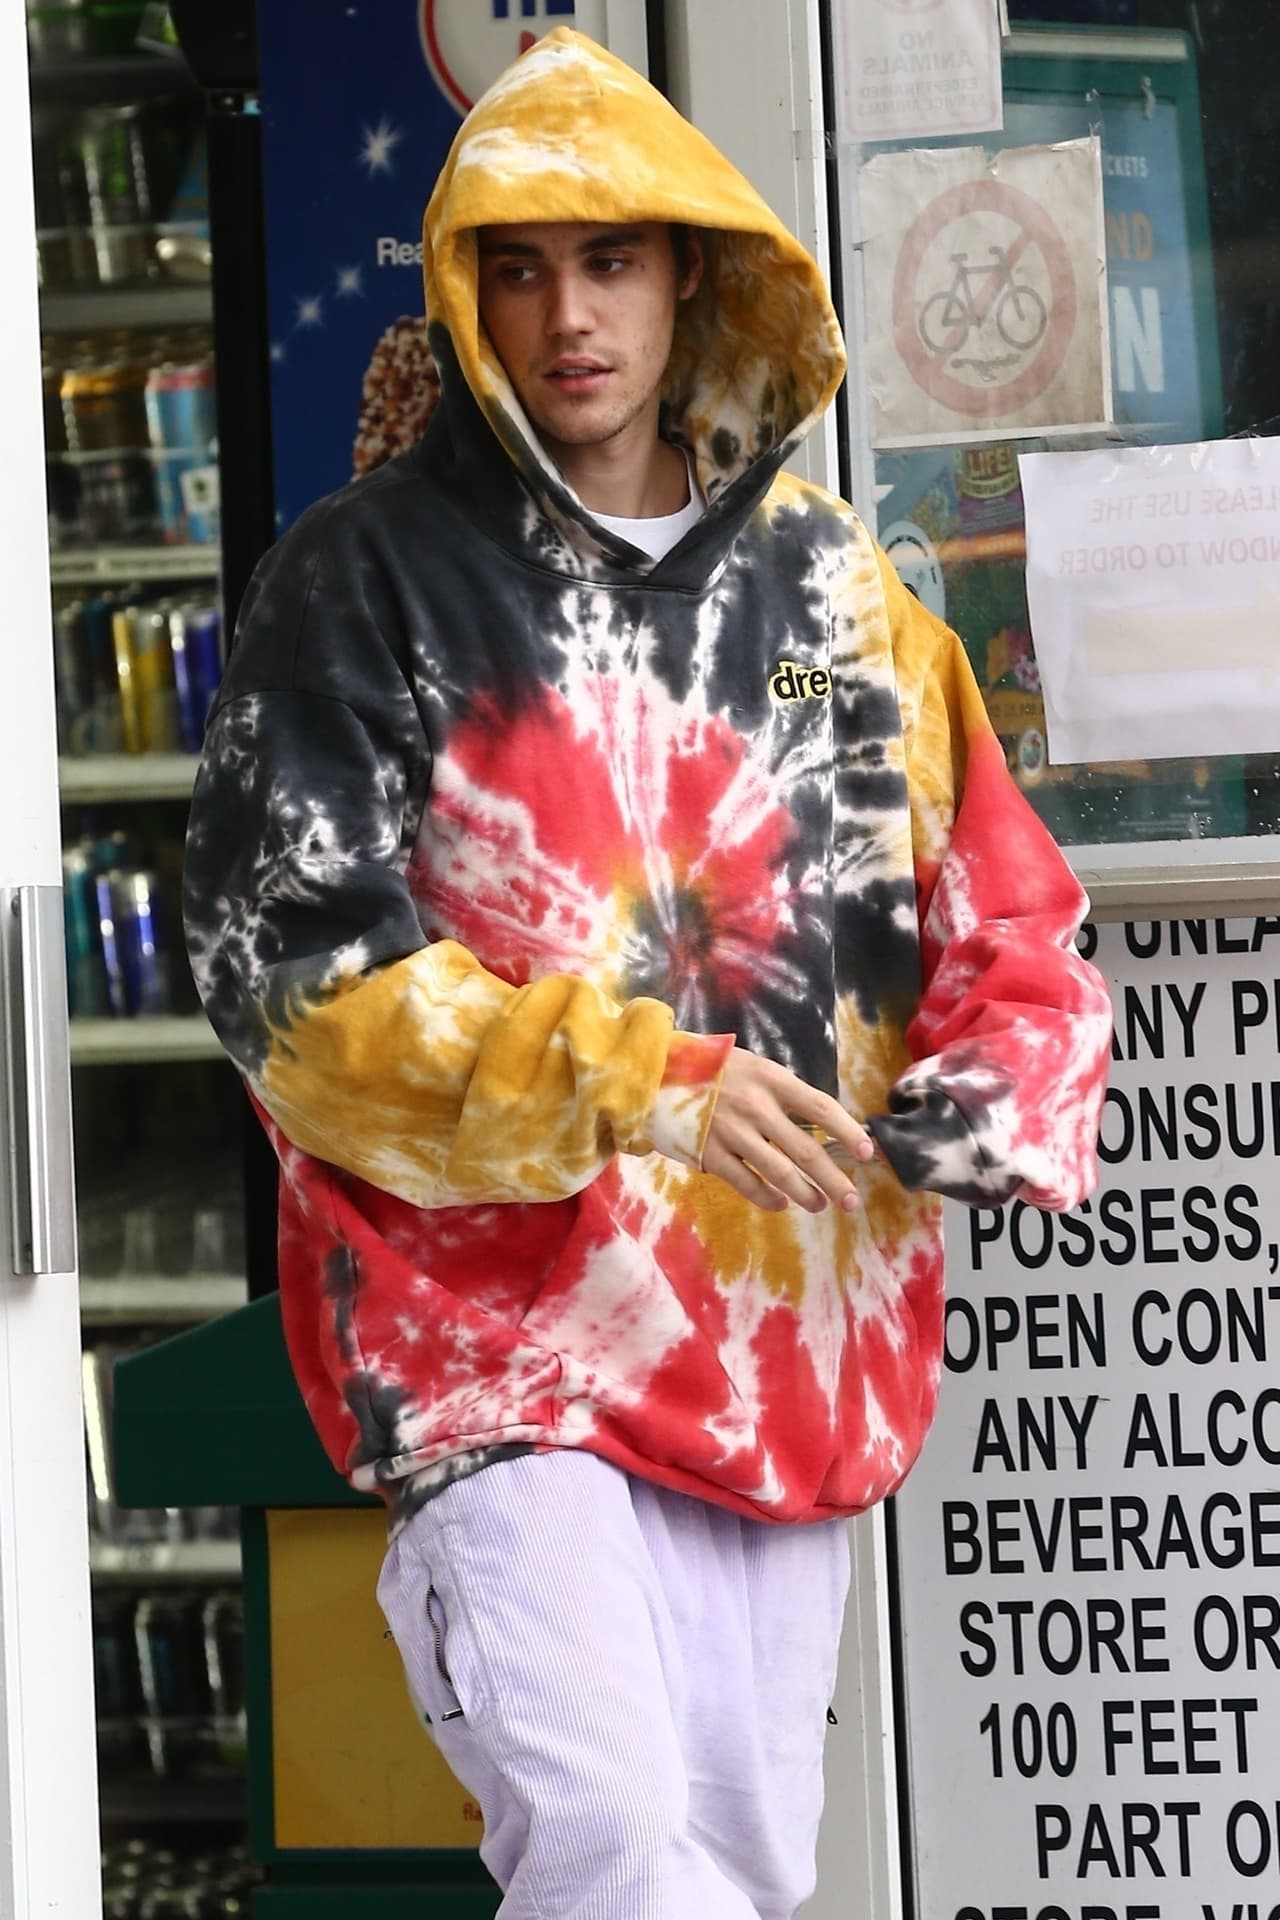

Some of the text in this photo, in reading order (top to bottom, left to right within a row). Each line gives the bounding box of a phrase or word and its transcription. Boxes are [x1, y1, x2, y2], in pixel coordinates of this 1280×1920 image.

[770, 661, 832, 700] dre
[1232, 979, 1280, 1056] P
[1098, 1081, 1280, 1164] ONSU
[970, 1184, 1279, 1275] POSSESS,
[944, 1293, 1107, 1374] OPEN
[973, 1388, 1280, 1473] ANY ALCO
[942, 1491, 1280, 1576] BEVERAGE
[960, 1594, 1280, 1678] STORE OR
[979, 1698, 1258, 1779] 100 FEET
[1035, 1800, 1280, 1879] PART O
